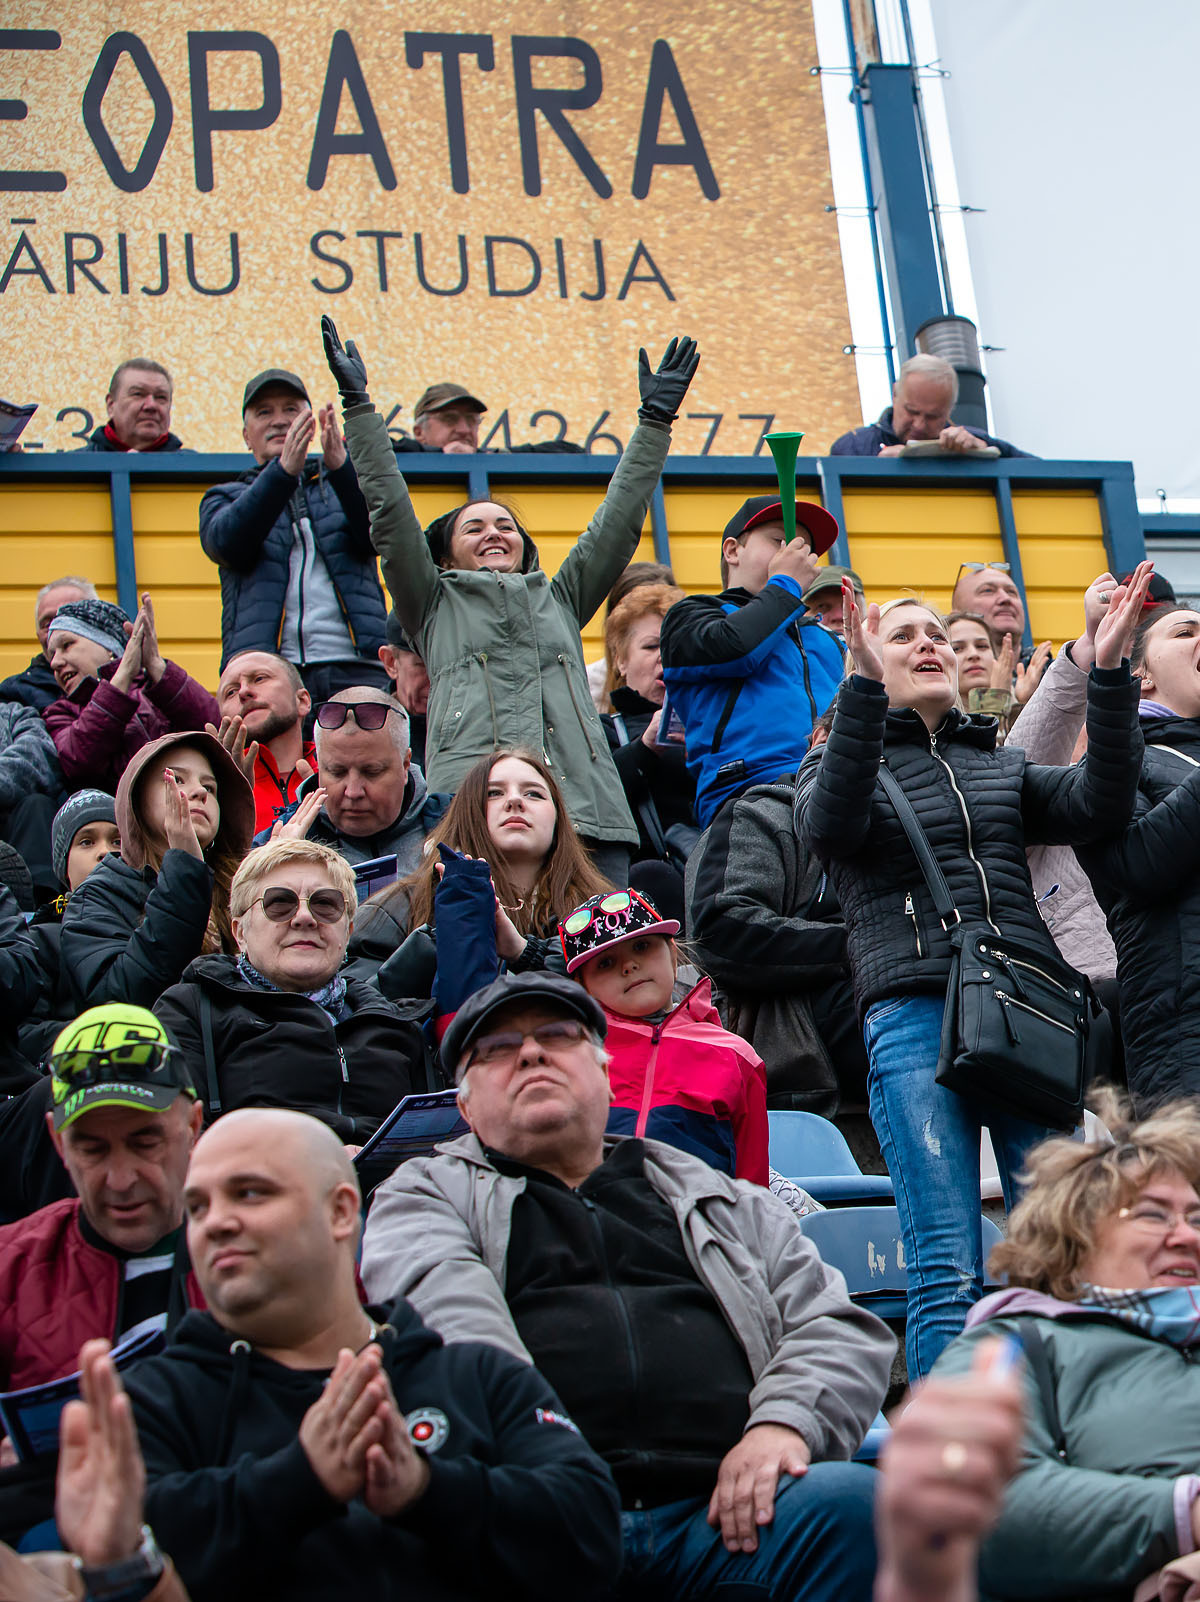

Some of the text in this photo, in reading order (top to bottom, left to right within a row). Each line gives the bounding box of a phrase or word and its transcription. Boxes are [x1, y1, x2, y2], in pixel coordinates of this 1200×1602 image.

[0, 217, 677, 302] ĀRIJU STUDIJA
[56, 1021, 162, 1074] 46
